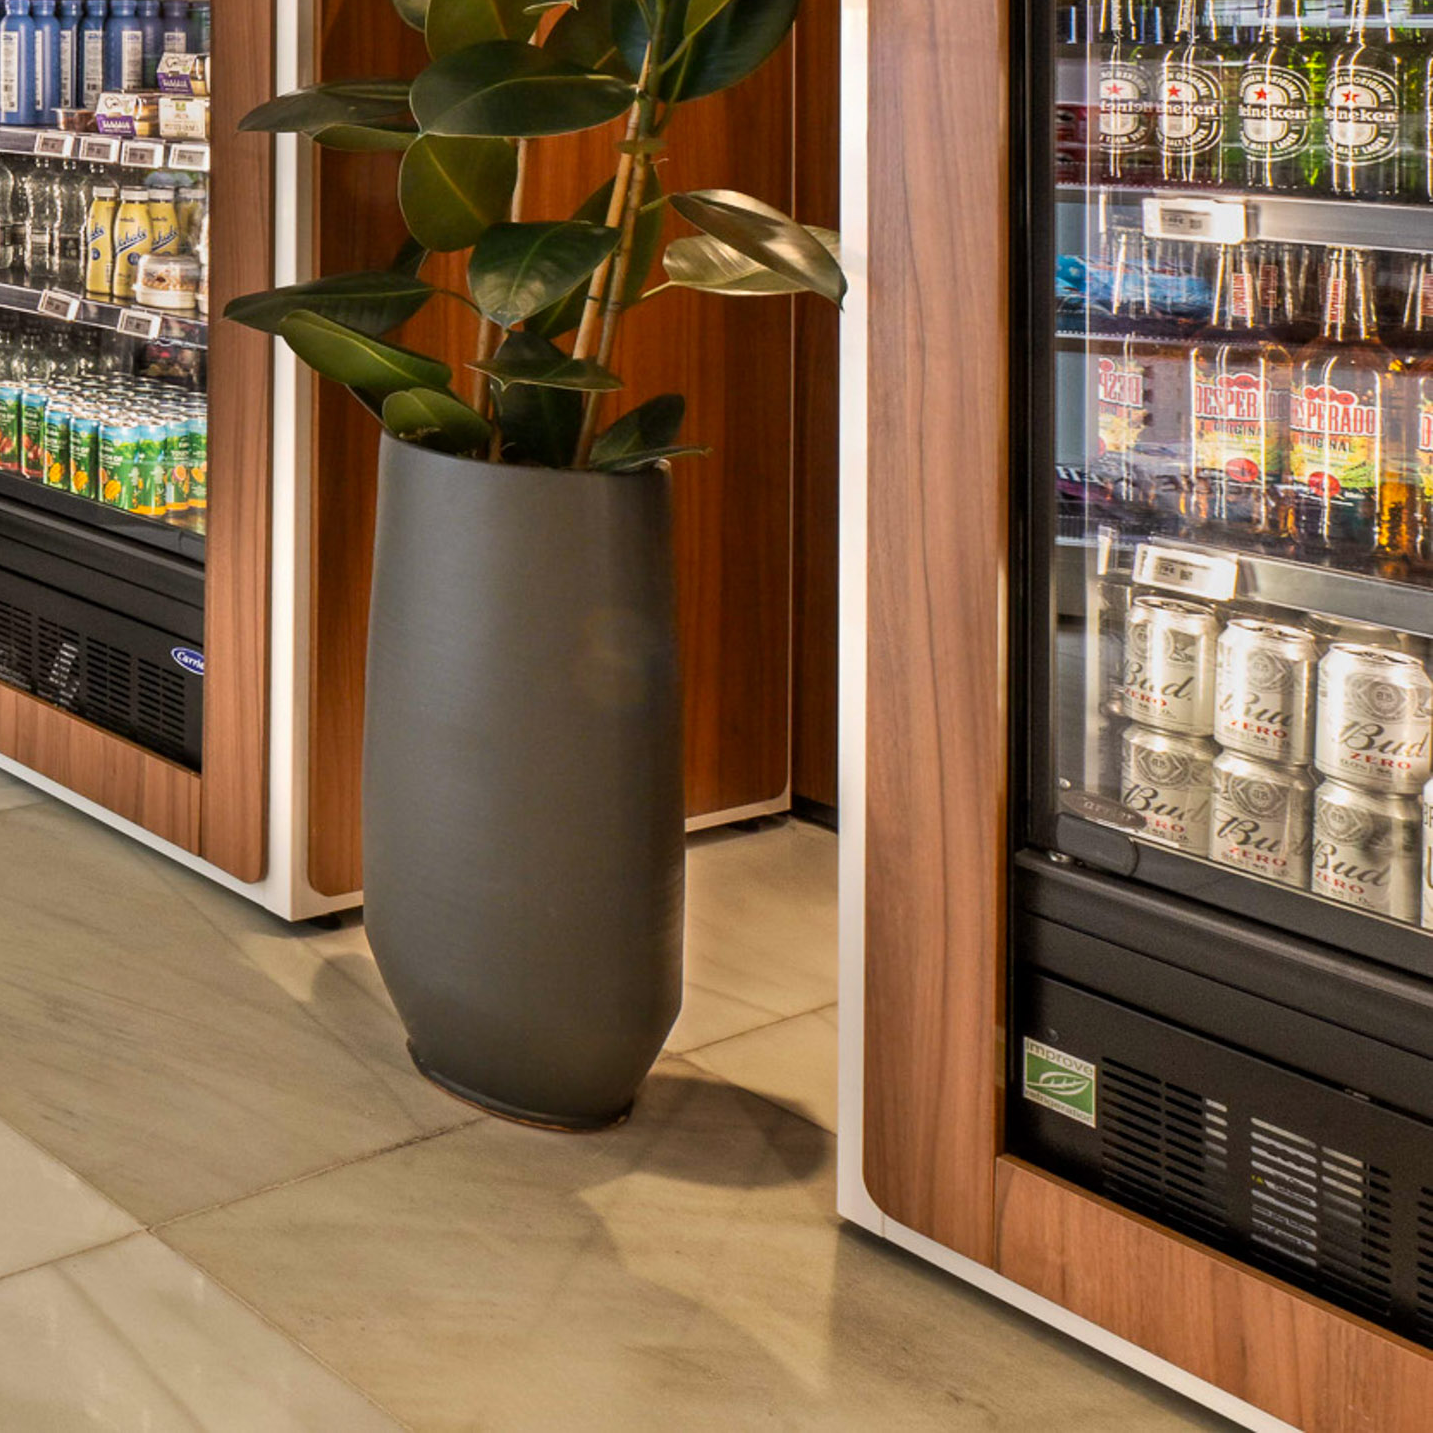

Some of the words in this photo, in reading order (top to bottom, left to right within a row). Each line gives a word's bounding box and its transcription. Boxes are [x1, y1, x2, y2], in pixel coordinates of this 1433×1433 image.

[1230, 719, 1288, 739] ZERO
[1350, 752, 1412, 770] ZERO
[1229, 847, 1287, 867] ZERO
[1315, 871, 1365, 895] ZERO
[1025, 1038, 1094, 1078] improve
[1026, 1088, 1094, 1125] refrigeration
